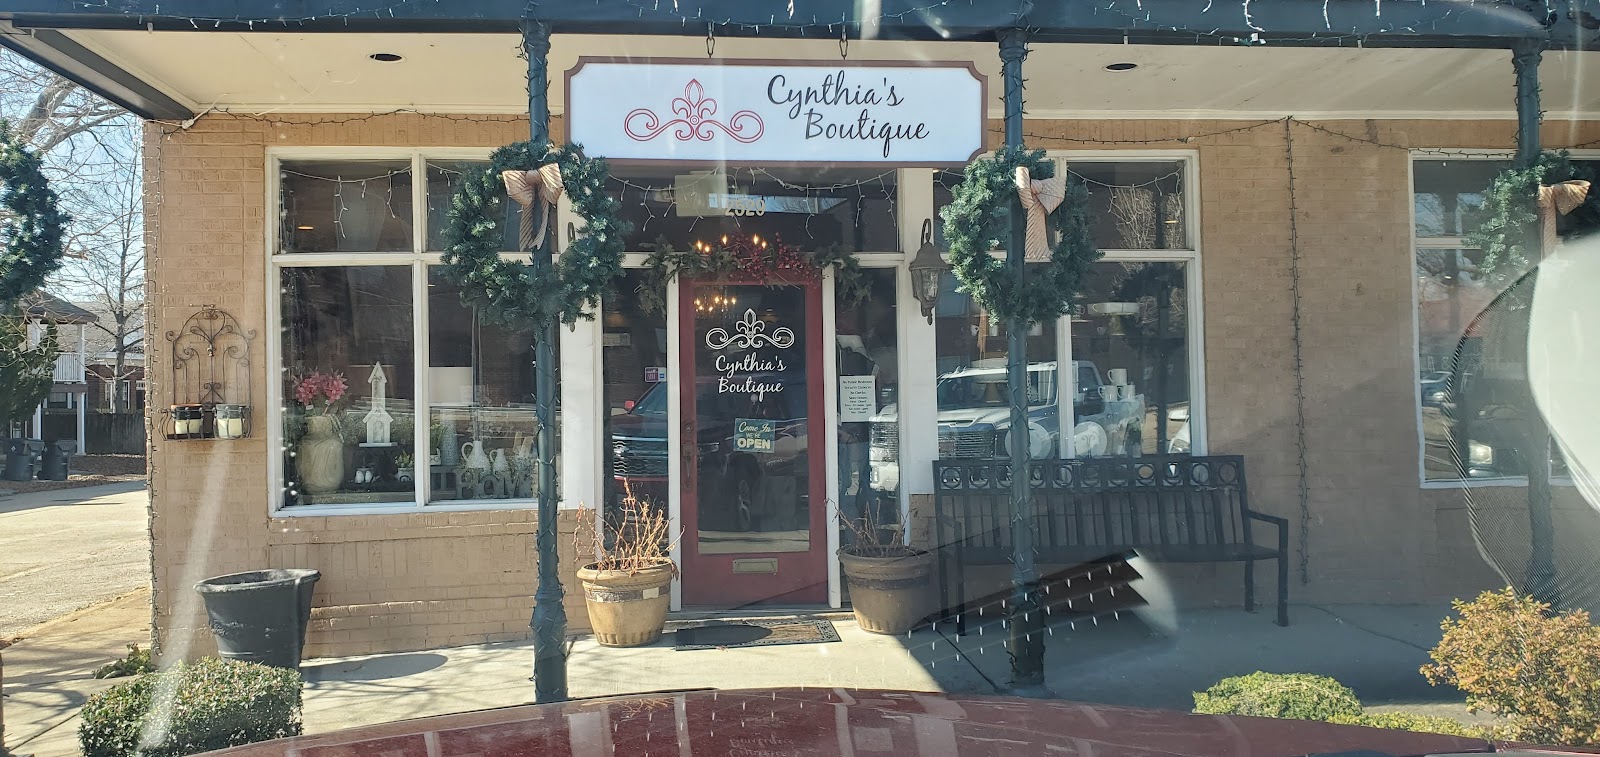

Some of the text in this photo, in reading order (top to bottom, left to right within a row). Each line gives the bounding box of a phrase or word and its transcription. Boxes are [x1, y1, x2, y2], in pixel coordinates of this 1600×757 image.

[767, 70, 904, 119] Cynthia's
[804, 108, 930, 158] Boutique
[715, 352, 787, 378] Cynthia's
[718, 376, 784, 402] Boutique
[739, 421, 758, 432] Come
[737, 438, 771, 449] OPEN
